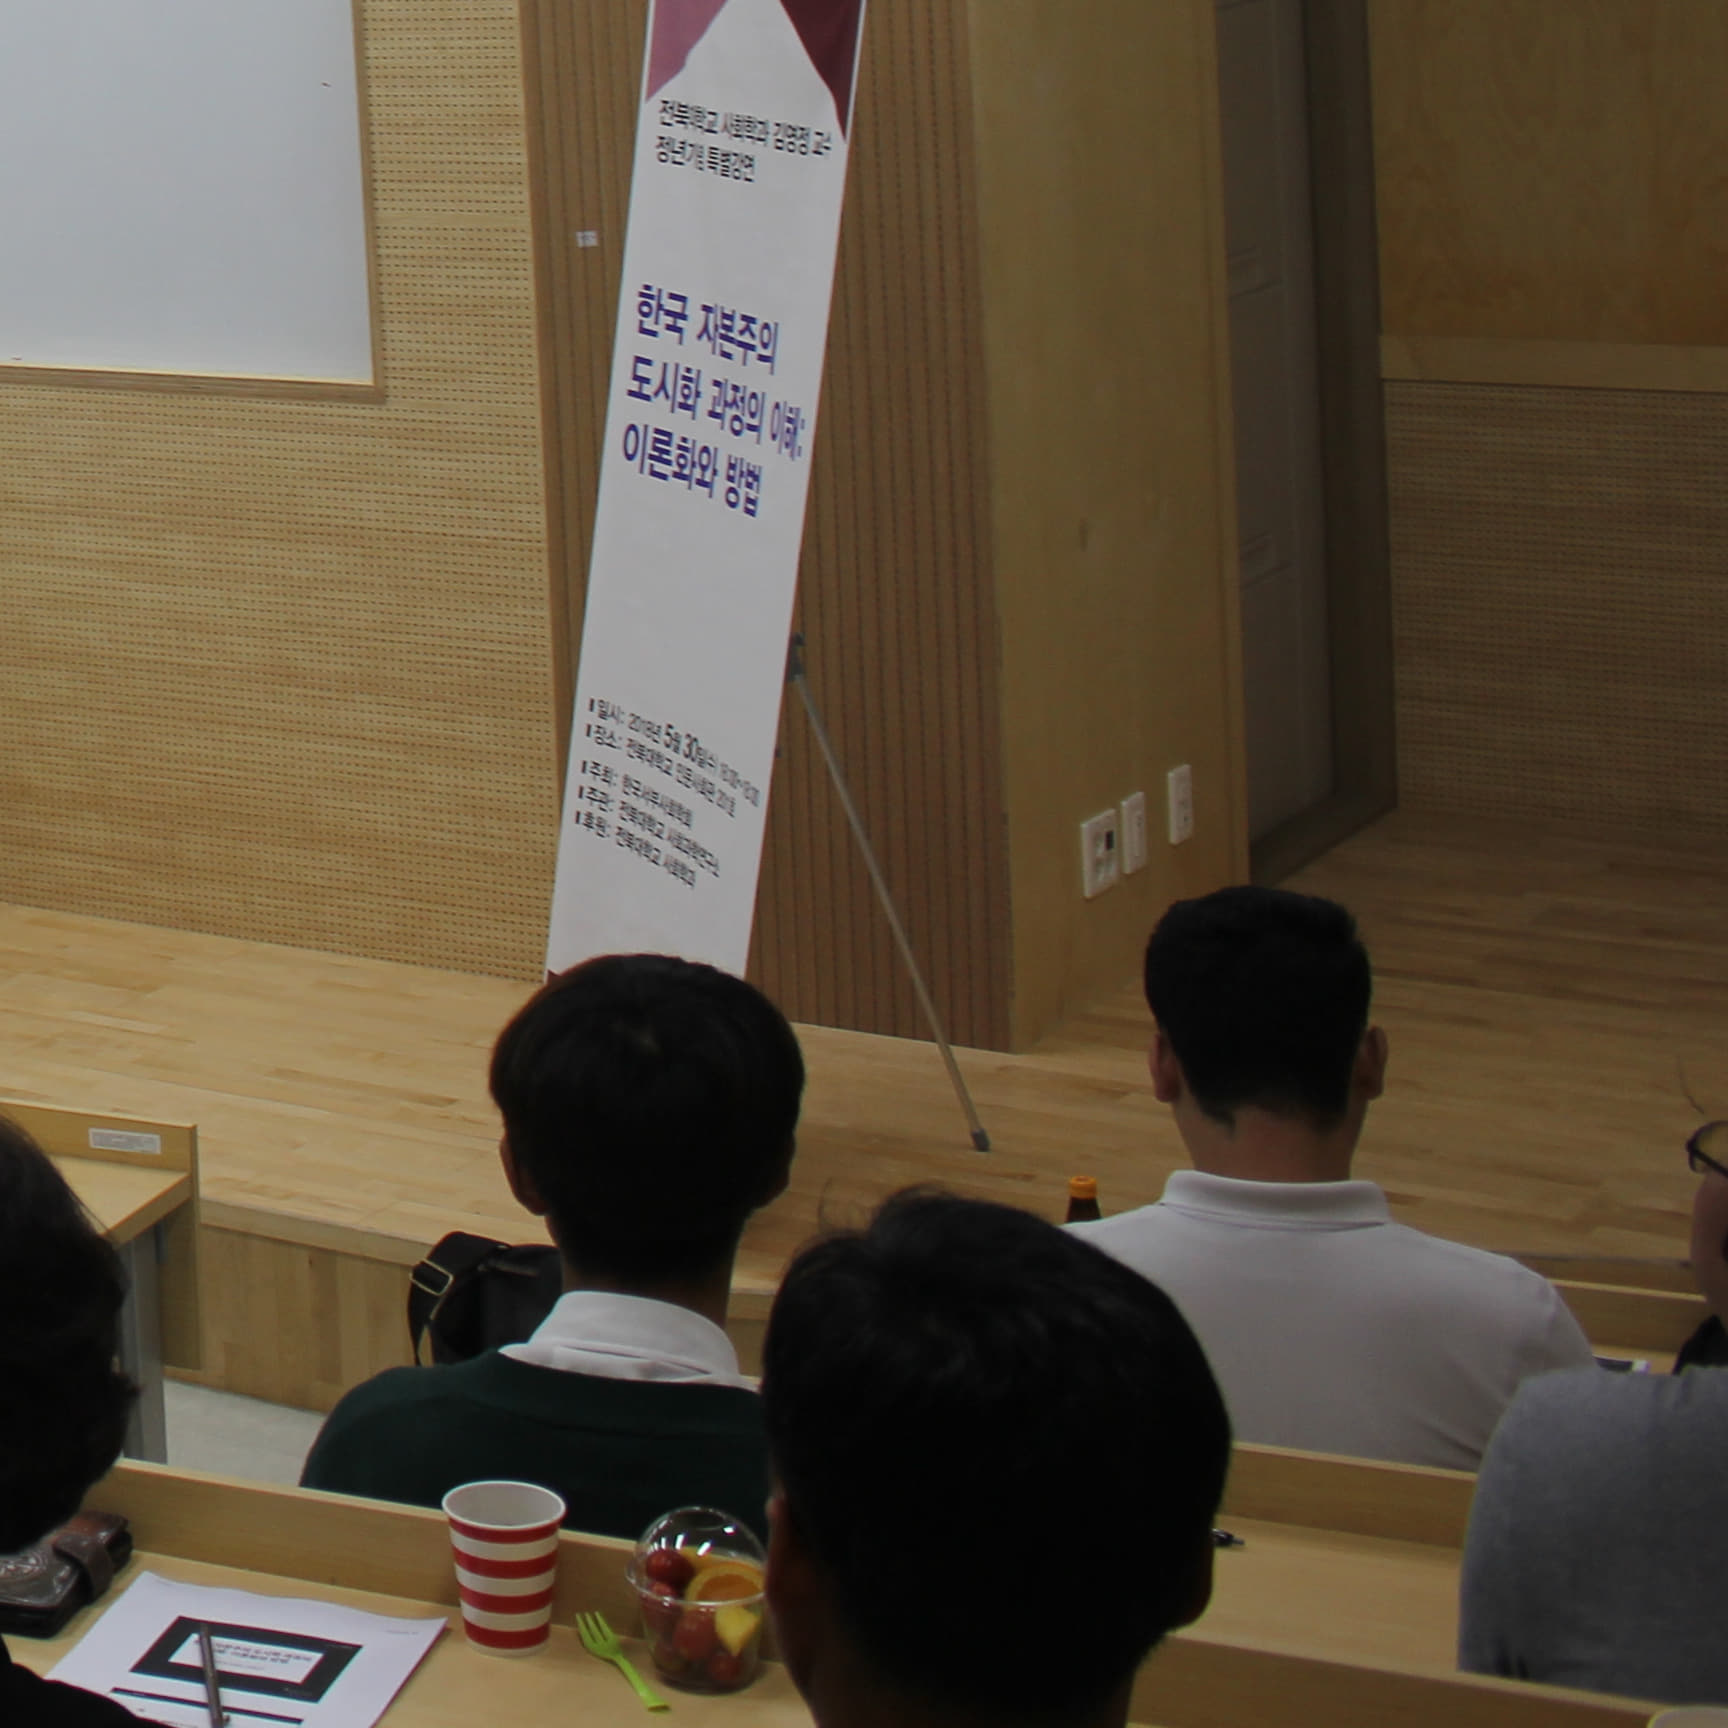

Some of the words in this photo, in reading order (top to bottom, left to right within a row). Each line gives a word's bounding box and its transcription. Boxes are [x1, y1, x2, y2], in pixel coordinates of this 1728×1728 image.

[638, 284, 688, 346] 한국
[697, 303, 779, 375] 자본주의
[627, 354, 702, 421] 도시화
[707, 378, 766, 445] 과정의
[623, 423, 719, 499] 이론화와
[724, 453, 763, 517] 방법
